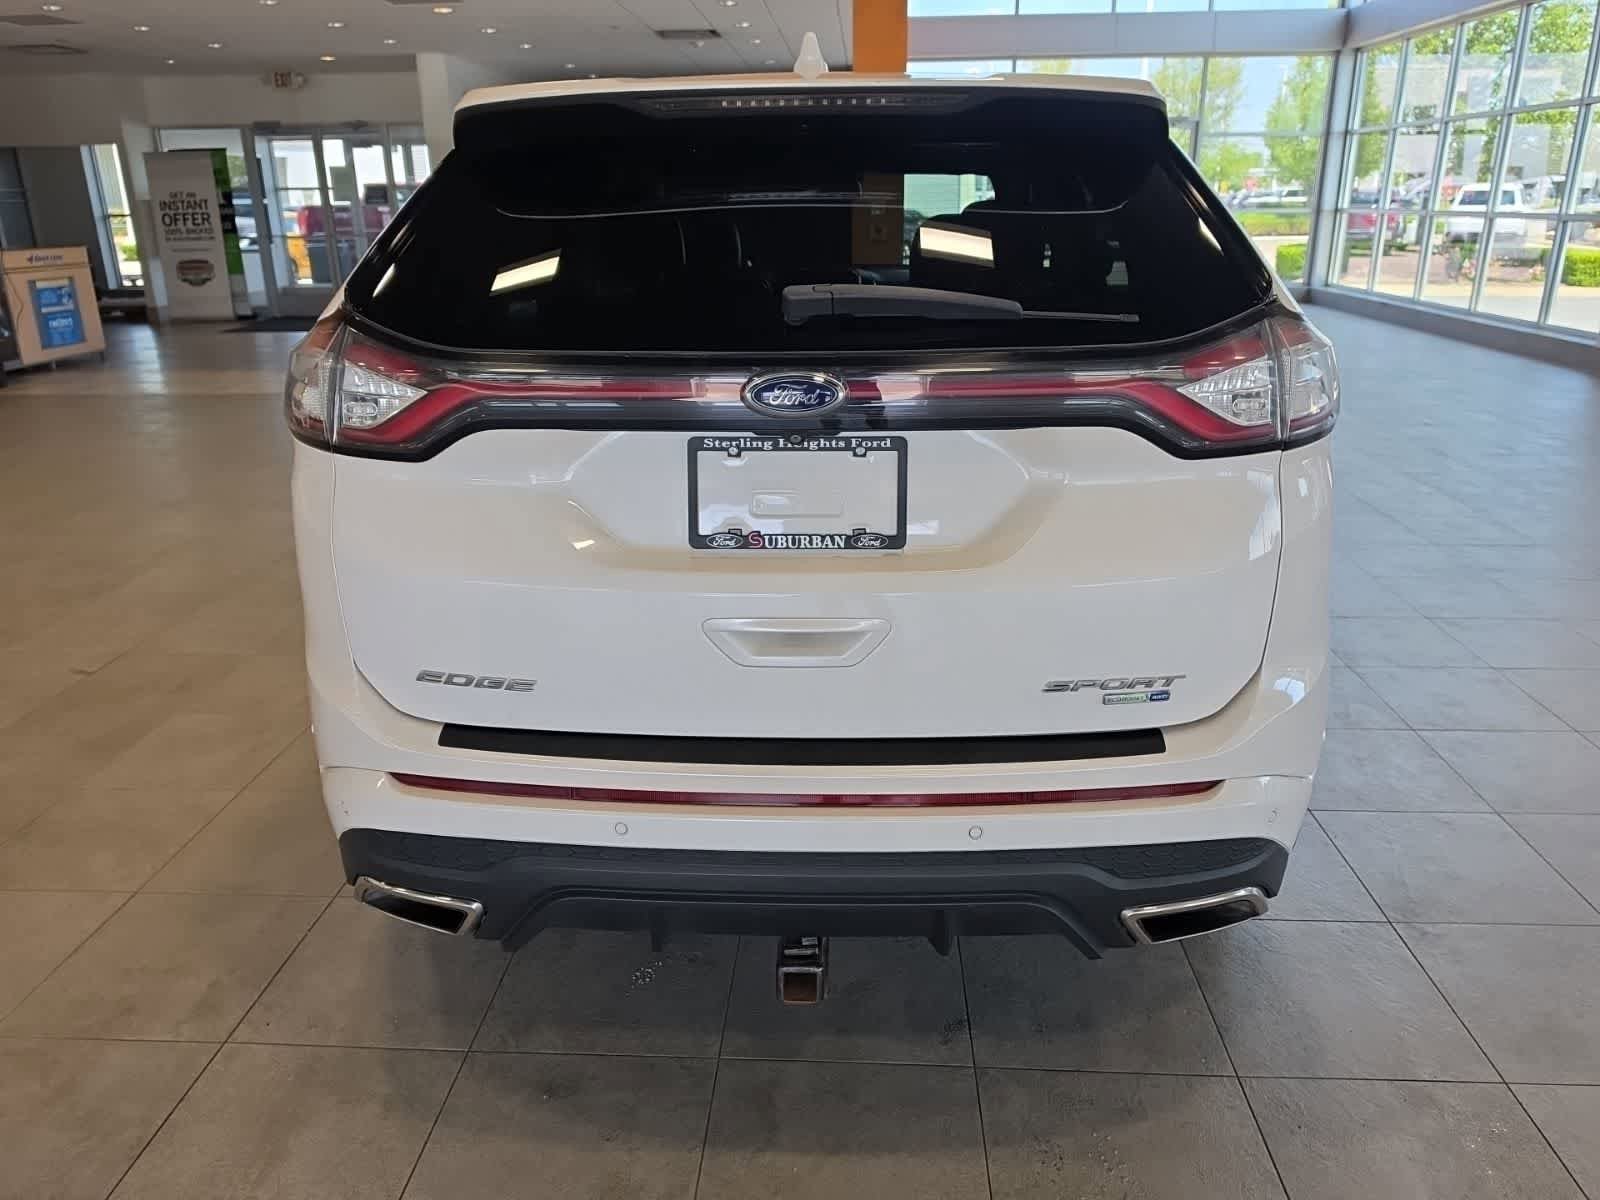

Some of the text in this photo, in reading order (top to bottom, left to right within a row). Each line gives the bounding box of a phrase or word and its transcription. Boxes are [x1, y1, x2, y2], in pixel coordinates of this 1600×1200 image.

[159, 199, 209, 211] INSTANT
[161, 212, 211, 227] OFFER
[768, 384, 821, 406] Ford
[703, 438, 773, 451] Sterling
[850, 438, 892, 448] Ford
[711, 535, 738, 547] Ford
[748, 532, 847, 549] SUBURBAN
[856, 535, 883, 547] Ford
[416, 669, 537, 693] EDGE
[1041, 674, 1187, 693] SPORT
